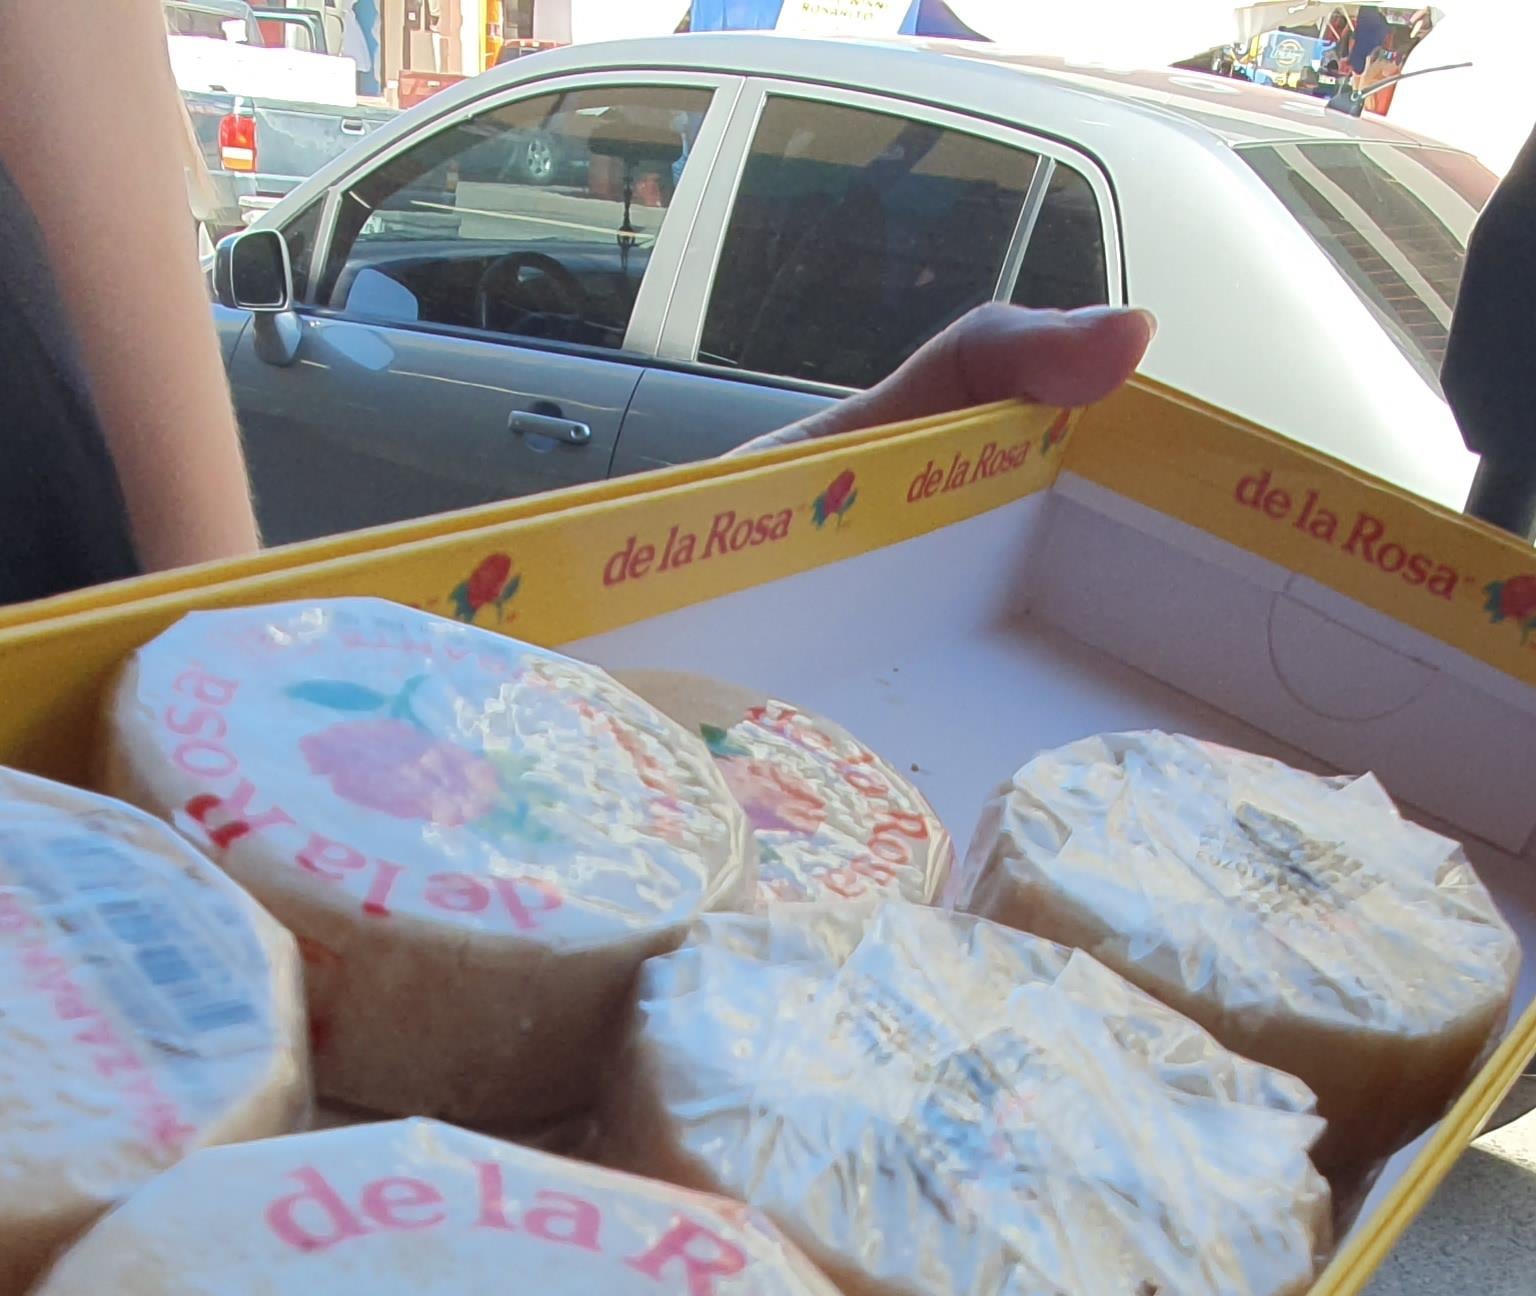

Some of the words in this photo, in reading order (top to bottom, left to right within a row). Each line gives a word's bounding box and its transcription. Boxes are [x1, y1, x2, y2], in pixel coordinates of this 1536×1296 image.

[907, 460, 943, 503] de
[941, 451, 970, 493] la
[970, 441, 1031, 483] Rosa
[602, 534, 656, 587] de
[656, 523, 697, 572] la
[700, 508, 793, 560] Rosa
[1235, 469, 1292, 520] de
[1292, 488, 1338, 543] la
[1340, 511, 1459, 600] Rosa
[165, 661, 297, 849] Rosa
[294, 833, 407, 918] la
[425, 870, 562, 931] de
[266, 1164, 447, 1254] de
[470, 1160, 605, 1254] la
